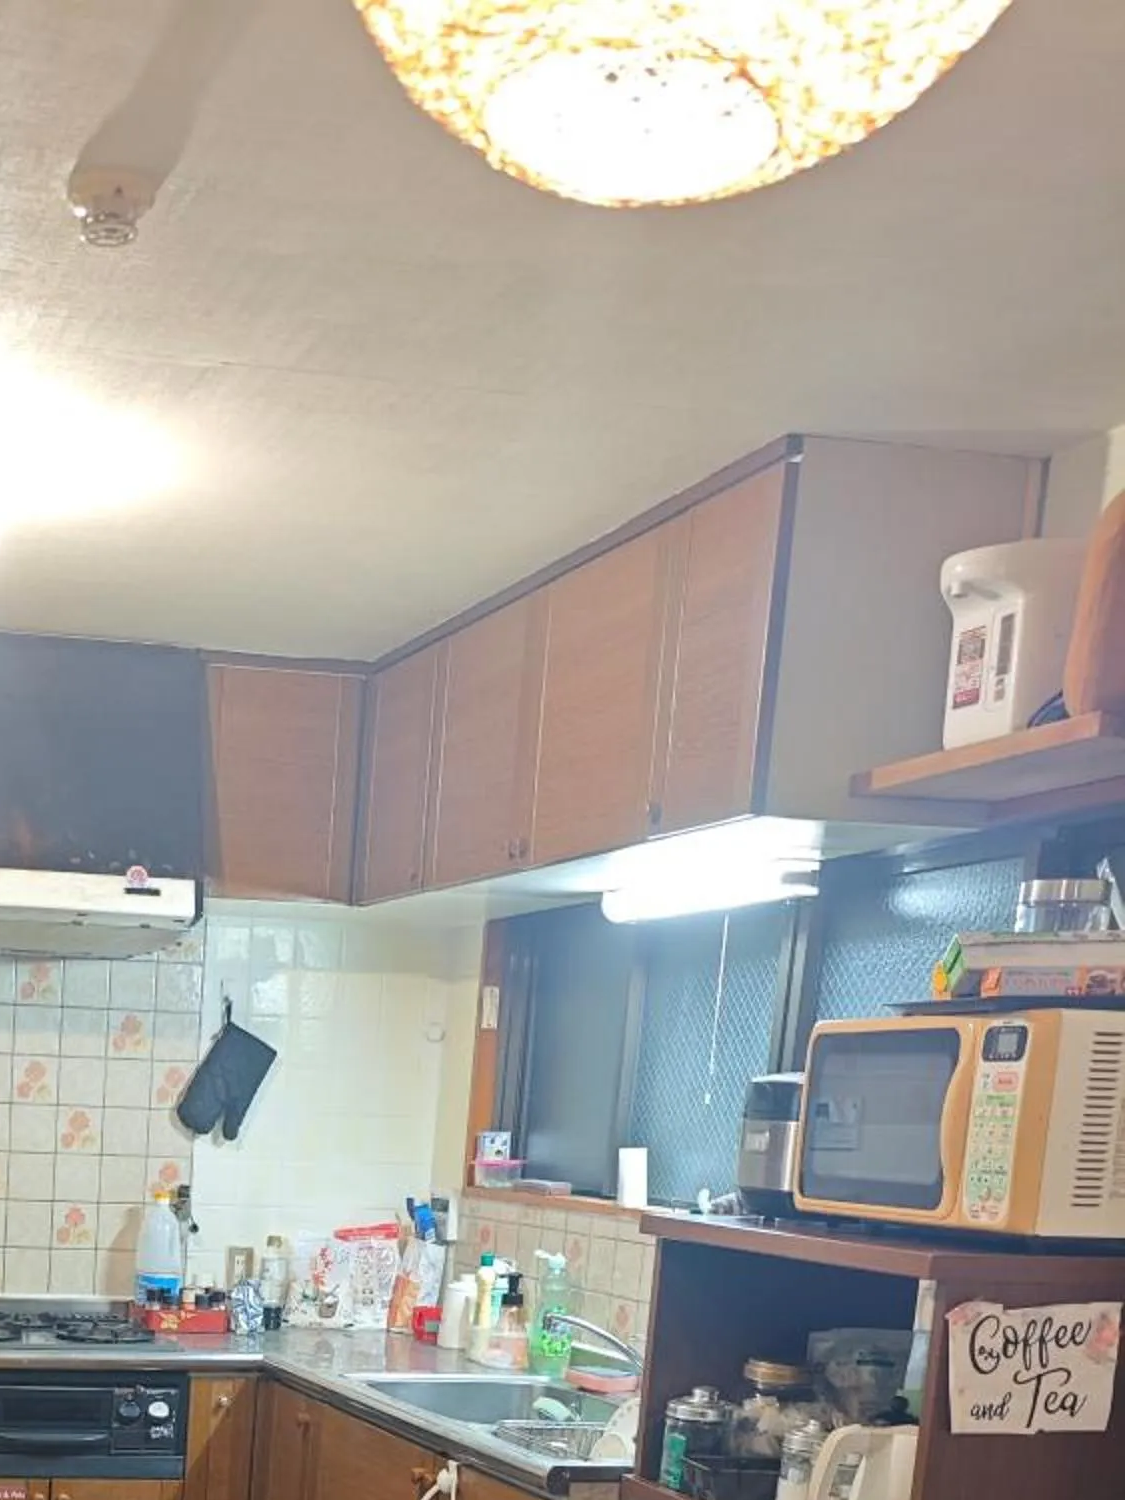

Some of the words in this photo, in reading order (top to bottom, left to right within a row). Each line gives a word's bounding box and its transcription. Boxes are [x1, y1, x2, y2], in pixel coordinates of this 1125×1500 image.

[968, 1314, 1092, 1375] Coffee
[970, 1391, 1012, 1421] and
[1013, 1367, 1087, 1428] Tea
